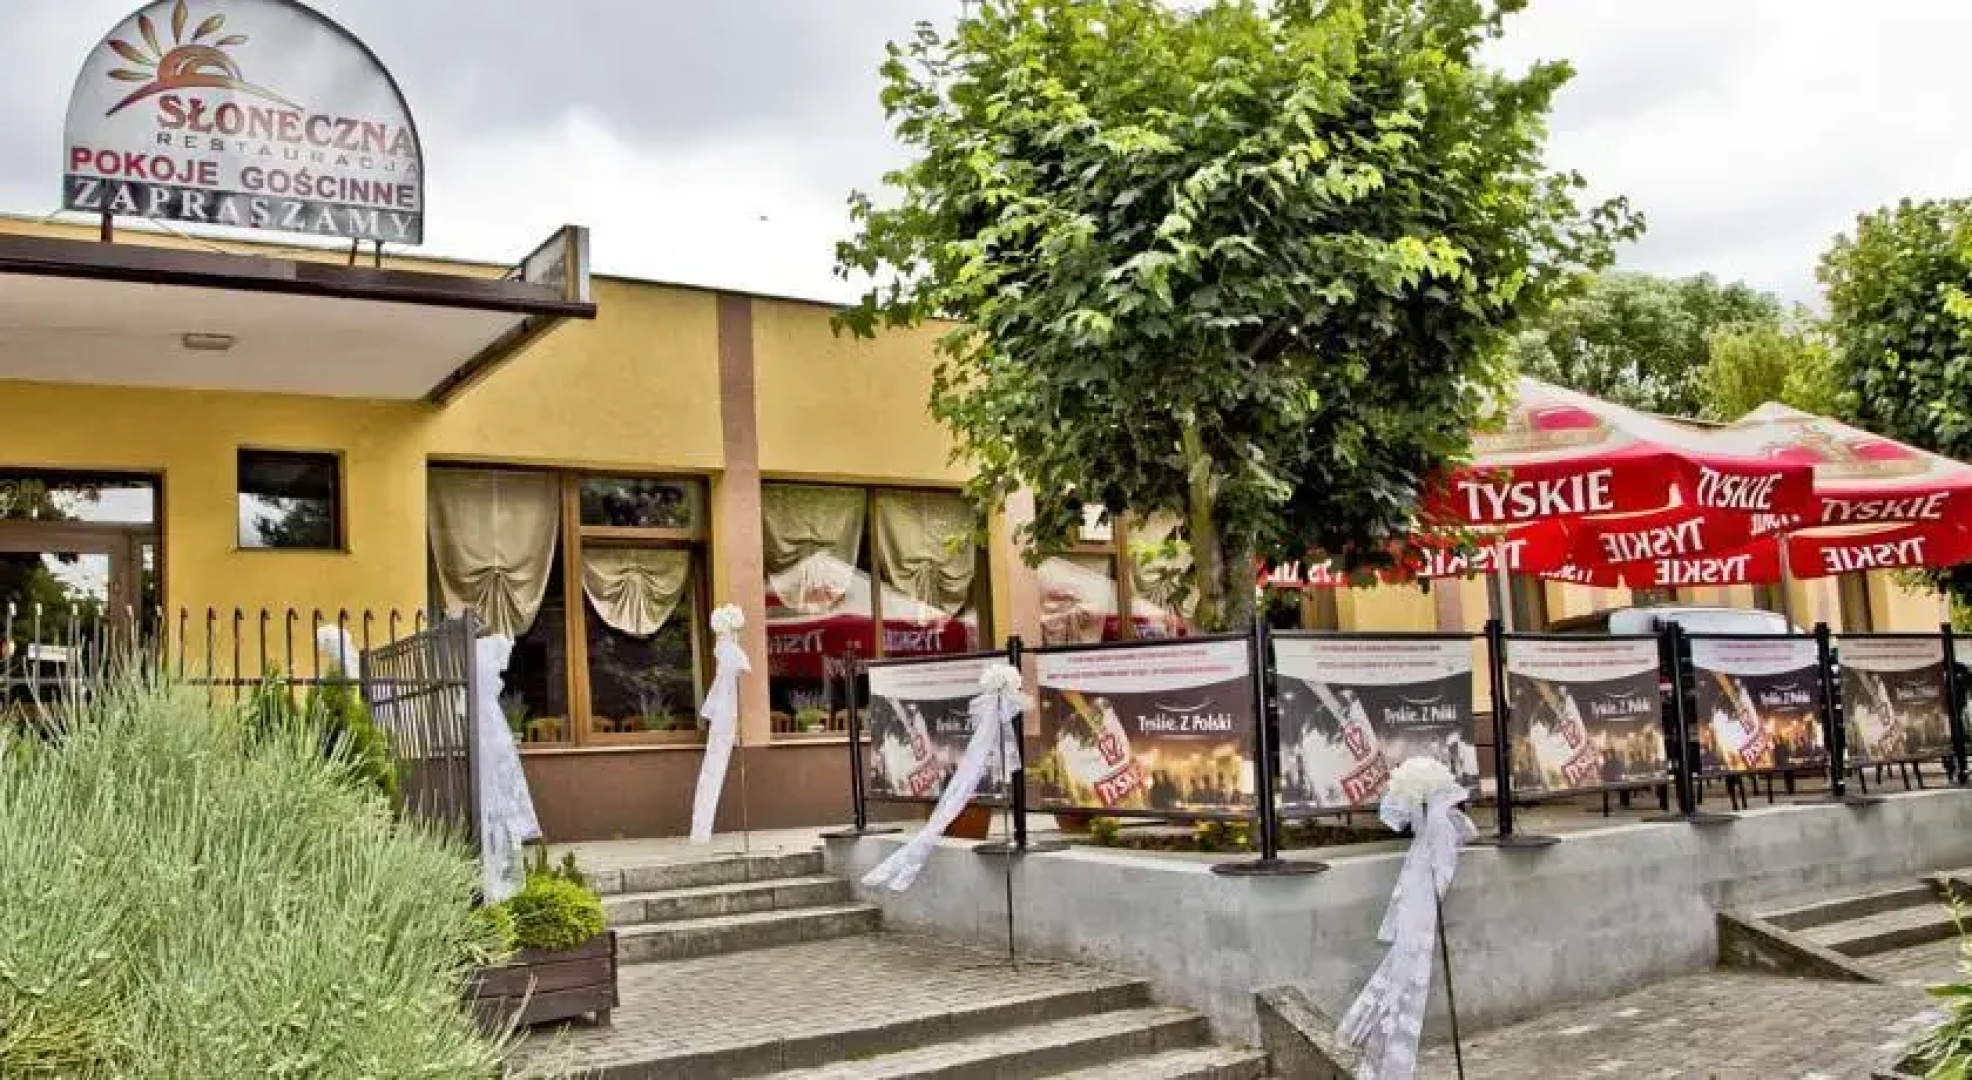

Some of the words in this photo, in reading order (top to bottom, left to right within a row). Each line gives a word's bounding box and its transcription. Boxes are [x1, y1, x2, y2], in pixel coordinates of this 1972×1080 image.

[156, 94, 418, 157] SŁONECZNA
[156, 132, 420, 173] RESTAURACJA
[69, 146, 219, 186] POKOJE
[240, 165, 415, 208] GOŚCINNE
[73, 178, 416, 239] ZAPRASZAMY
[1457, 467, 1614, 521] TYSKIE
[1697, 466, 1783, 509] TYSKIE
[1820, 492, 1950, 522] TYSKIE
